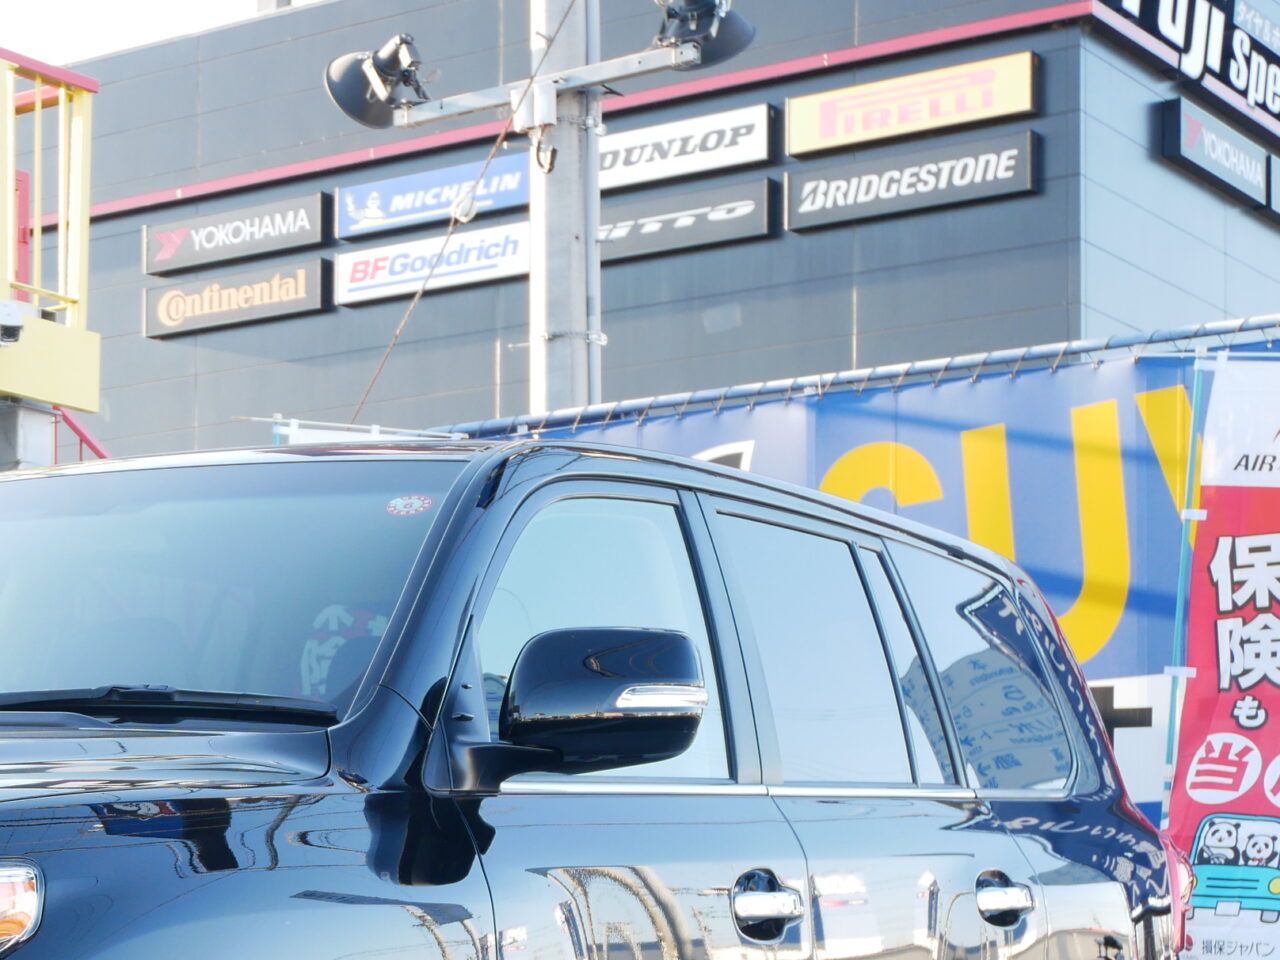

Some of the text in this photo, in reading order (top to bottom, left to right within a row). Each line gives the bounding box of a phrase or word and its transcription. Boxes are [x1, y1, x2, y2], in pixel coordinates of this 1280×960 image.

[819, 68, 996, 139] PIRELLI
[599, 123, 756, 171] DUNLOP
[1201, 127, 1264, 189] YOKOHAMA
[389, 172, 522, 213] MICHELIN
[797, 148, 1019, 214] BRIDGESTONE
[190, 208, 311, 251] YOKOHAMA
[349, 235, 520, 284] BFGoodrich
[157, 268, 307, 327] Continental
[1202, 939, 1276, 958] 損保ジャパン
